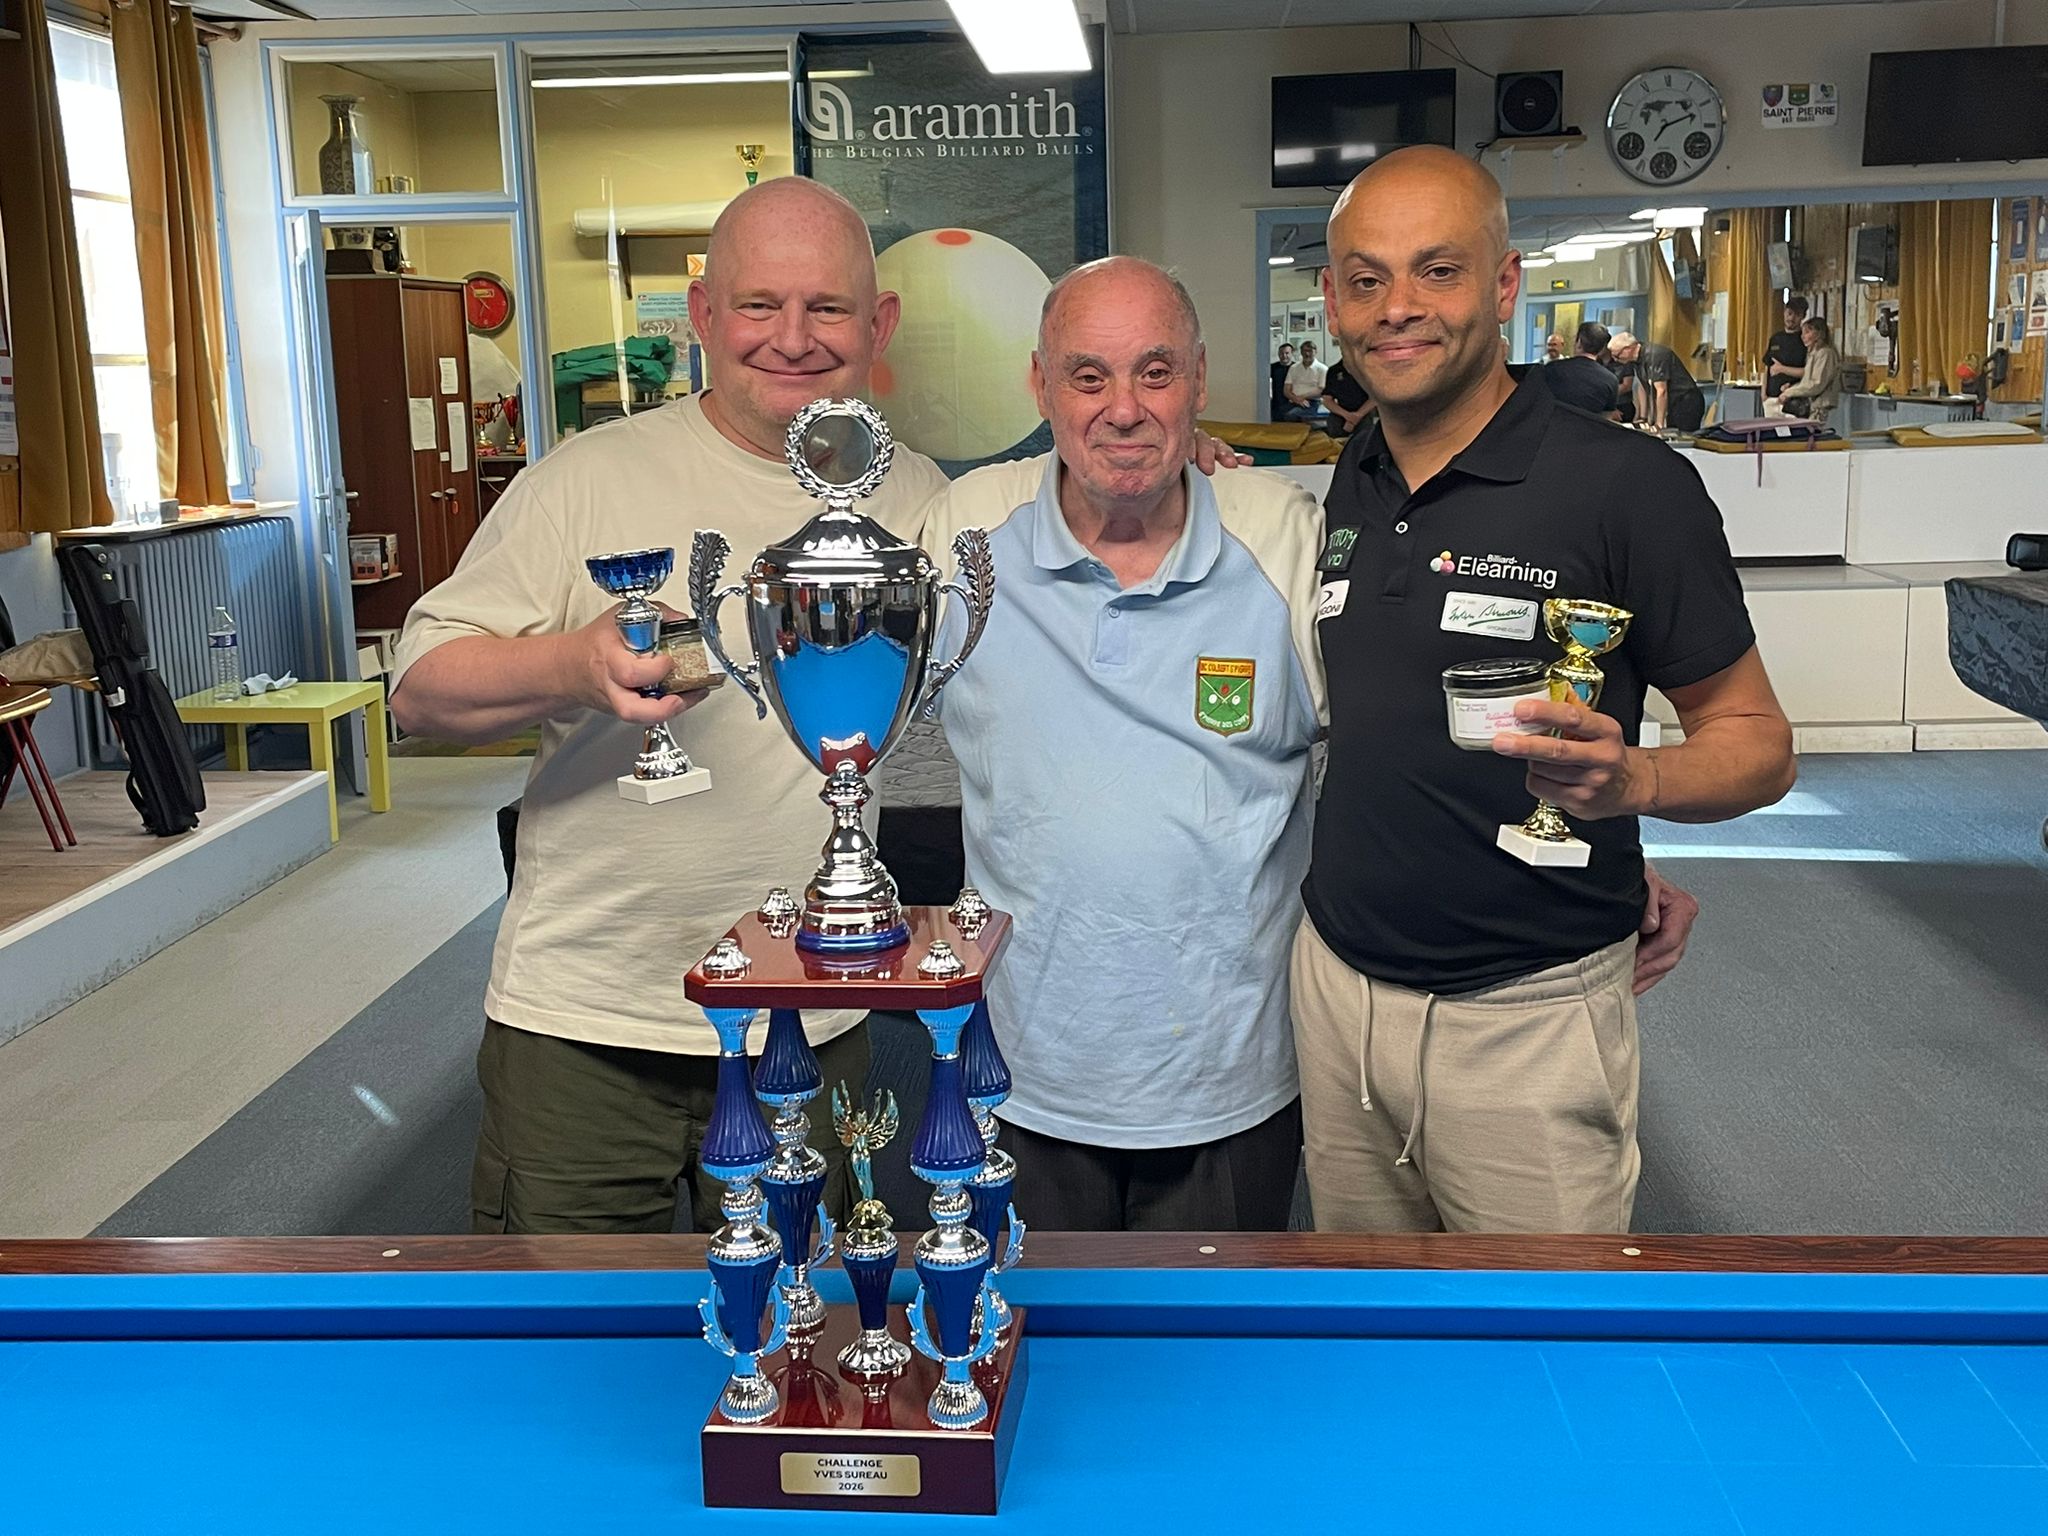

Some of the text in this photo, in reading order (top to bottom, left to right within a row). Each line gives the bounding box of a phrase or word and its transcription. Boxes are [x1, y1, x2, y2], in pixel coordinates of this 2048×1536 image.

[872, 88, 1081, 141] aramith
[1763, 106, 1835, 118] SAINT PIERRE
[846, 144, 926, 159] BELGIAN
[937, 144, 1025, 158] BILLIARD
[1037, 143, 1094, 157] BALLS
[1456, 556, 1558, 589] Elearning
[817, 1458, 883, 1468] CHALLENGE
[813, 1470, 888, 1480] YVES SUREAU
[838, 1482, 864, 1491] 2026
